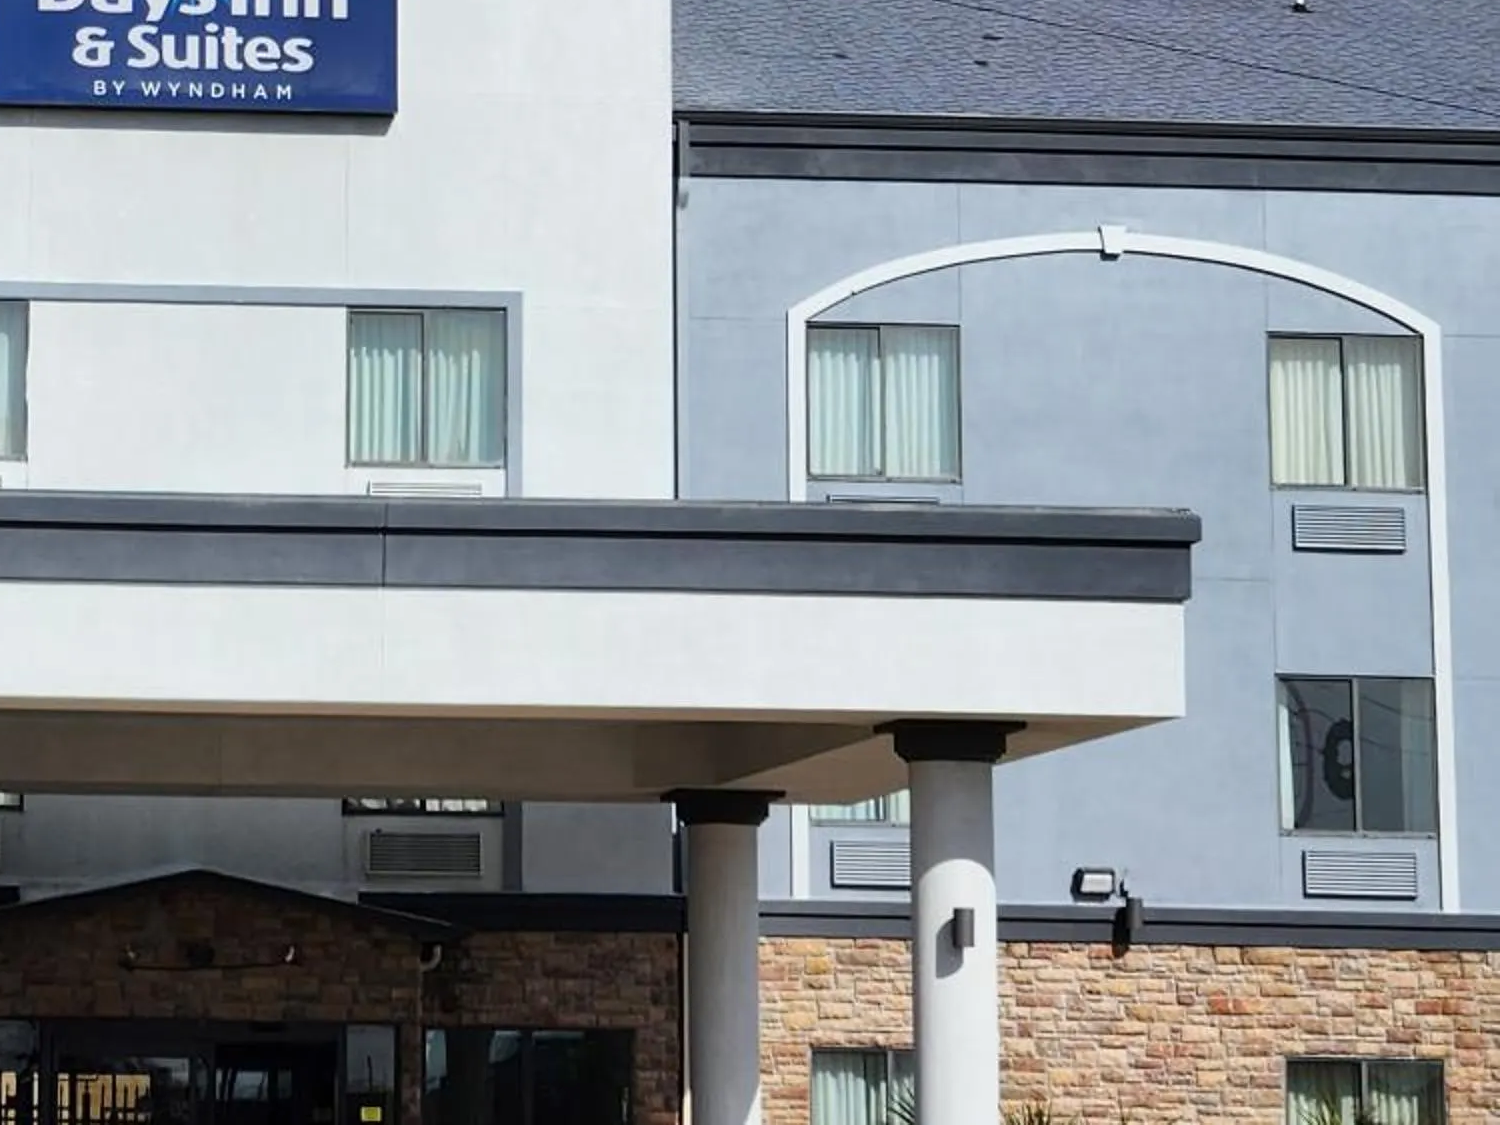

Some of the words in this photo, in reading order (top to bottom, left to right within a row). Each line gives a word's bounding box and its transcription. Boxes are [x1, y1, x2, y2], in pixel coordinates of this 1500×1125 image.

[71, 25, 115, 68] &
[126, 22, 315, 72] Suites
[93, 80, 126, 96] BY
[141, 81, 293, 101] WYNDHAM
